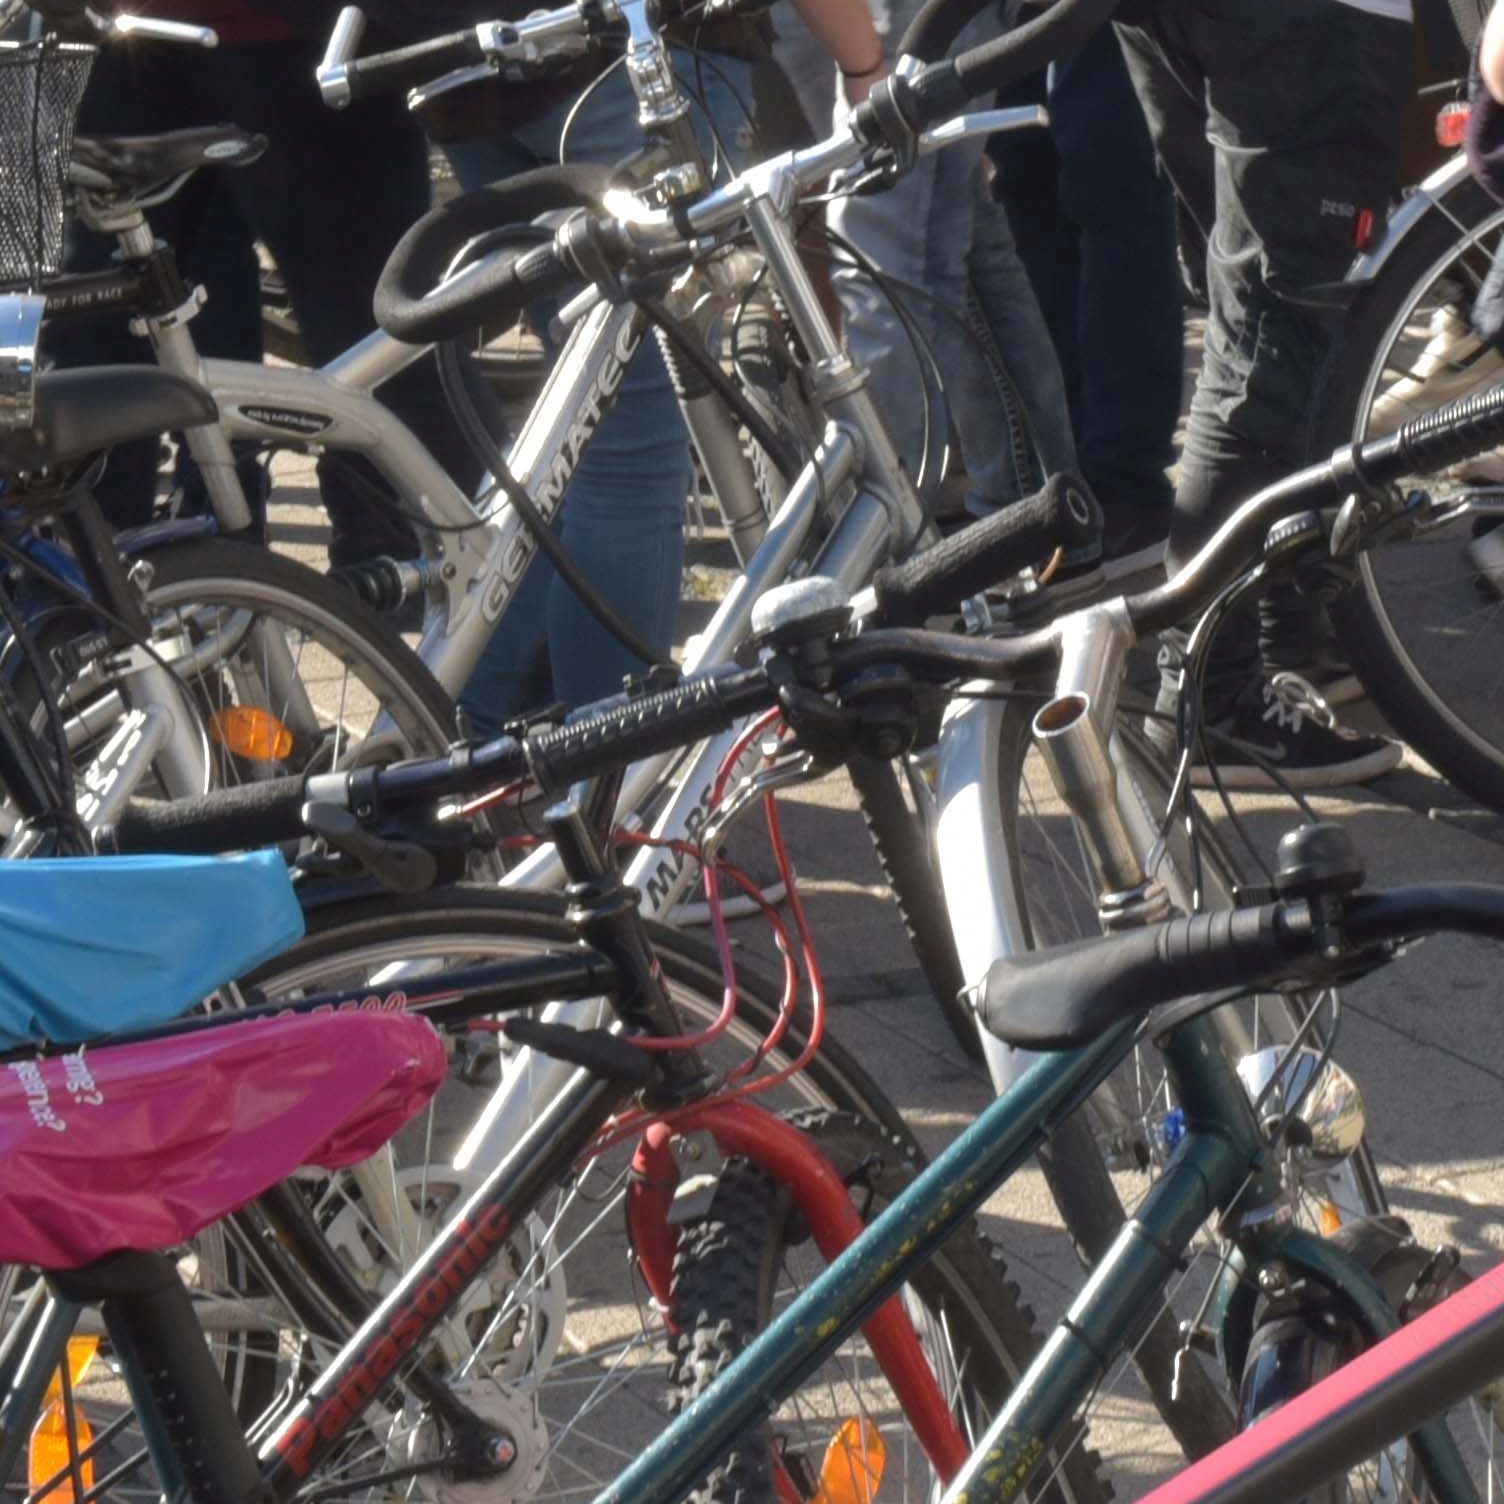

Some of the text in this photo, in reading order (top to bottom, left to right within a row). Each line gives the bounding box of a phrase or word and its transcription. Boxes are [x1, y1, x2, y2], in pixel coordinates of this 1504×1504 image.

[47, 288, 123, 311] ADY FOR RACE
[274, 1202, 511, 1476] Panasonic
